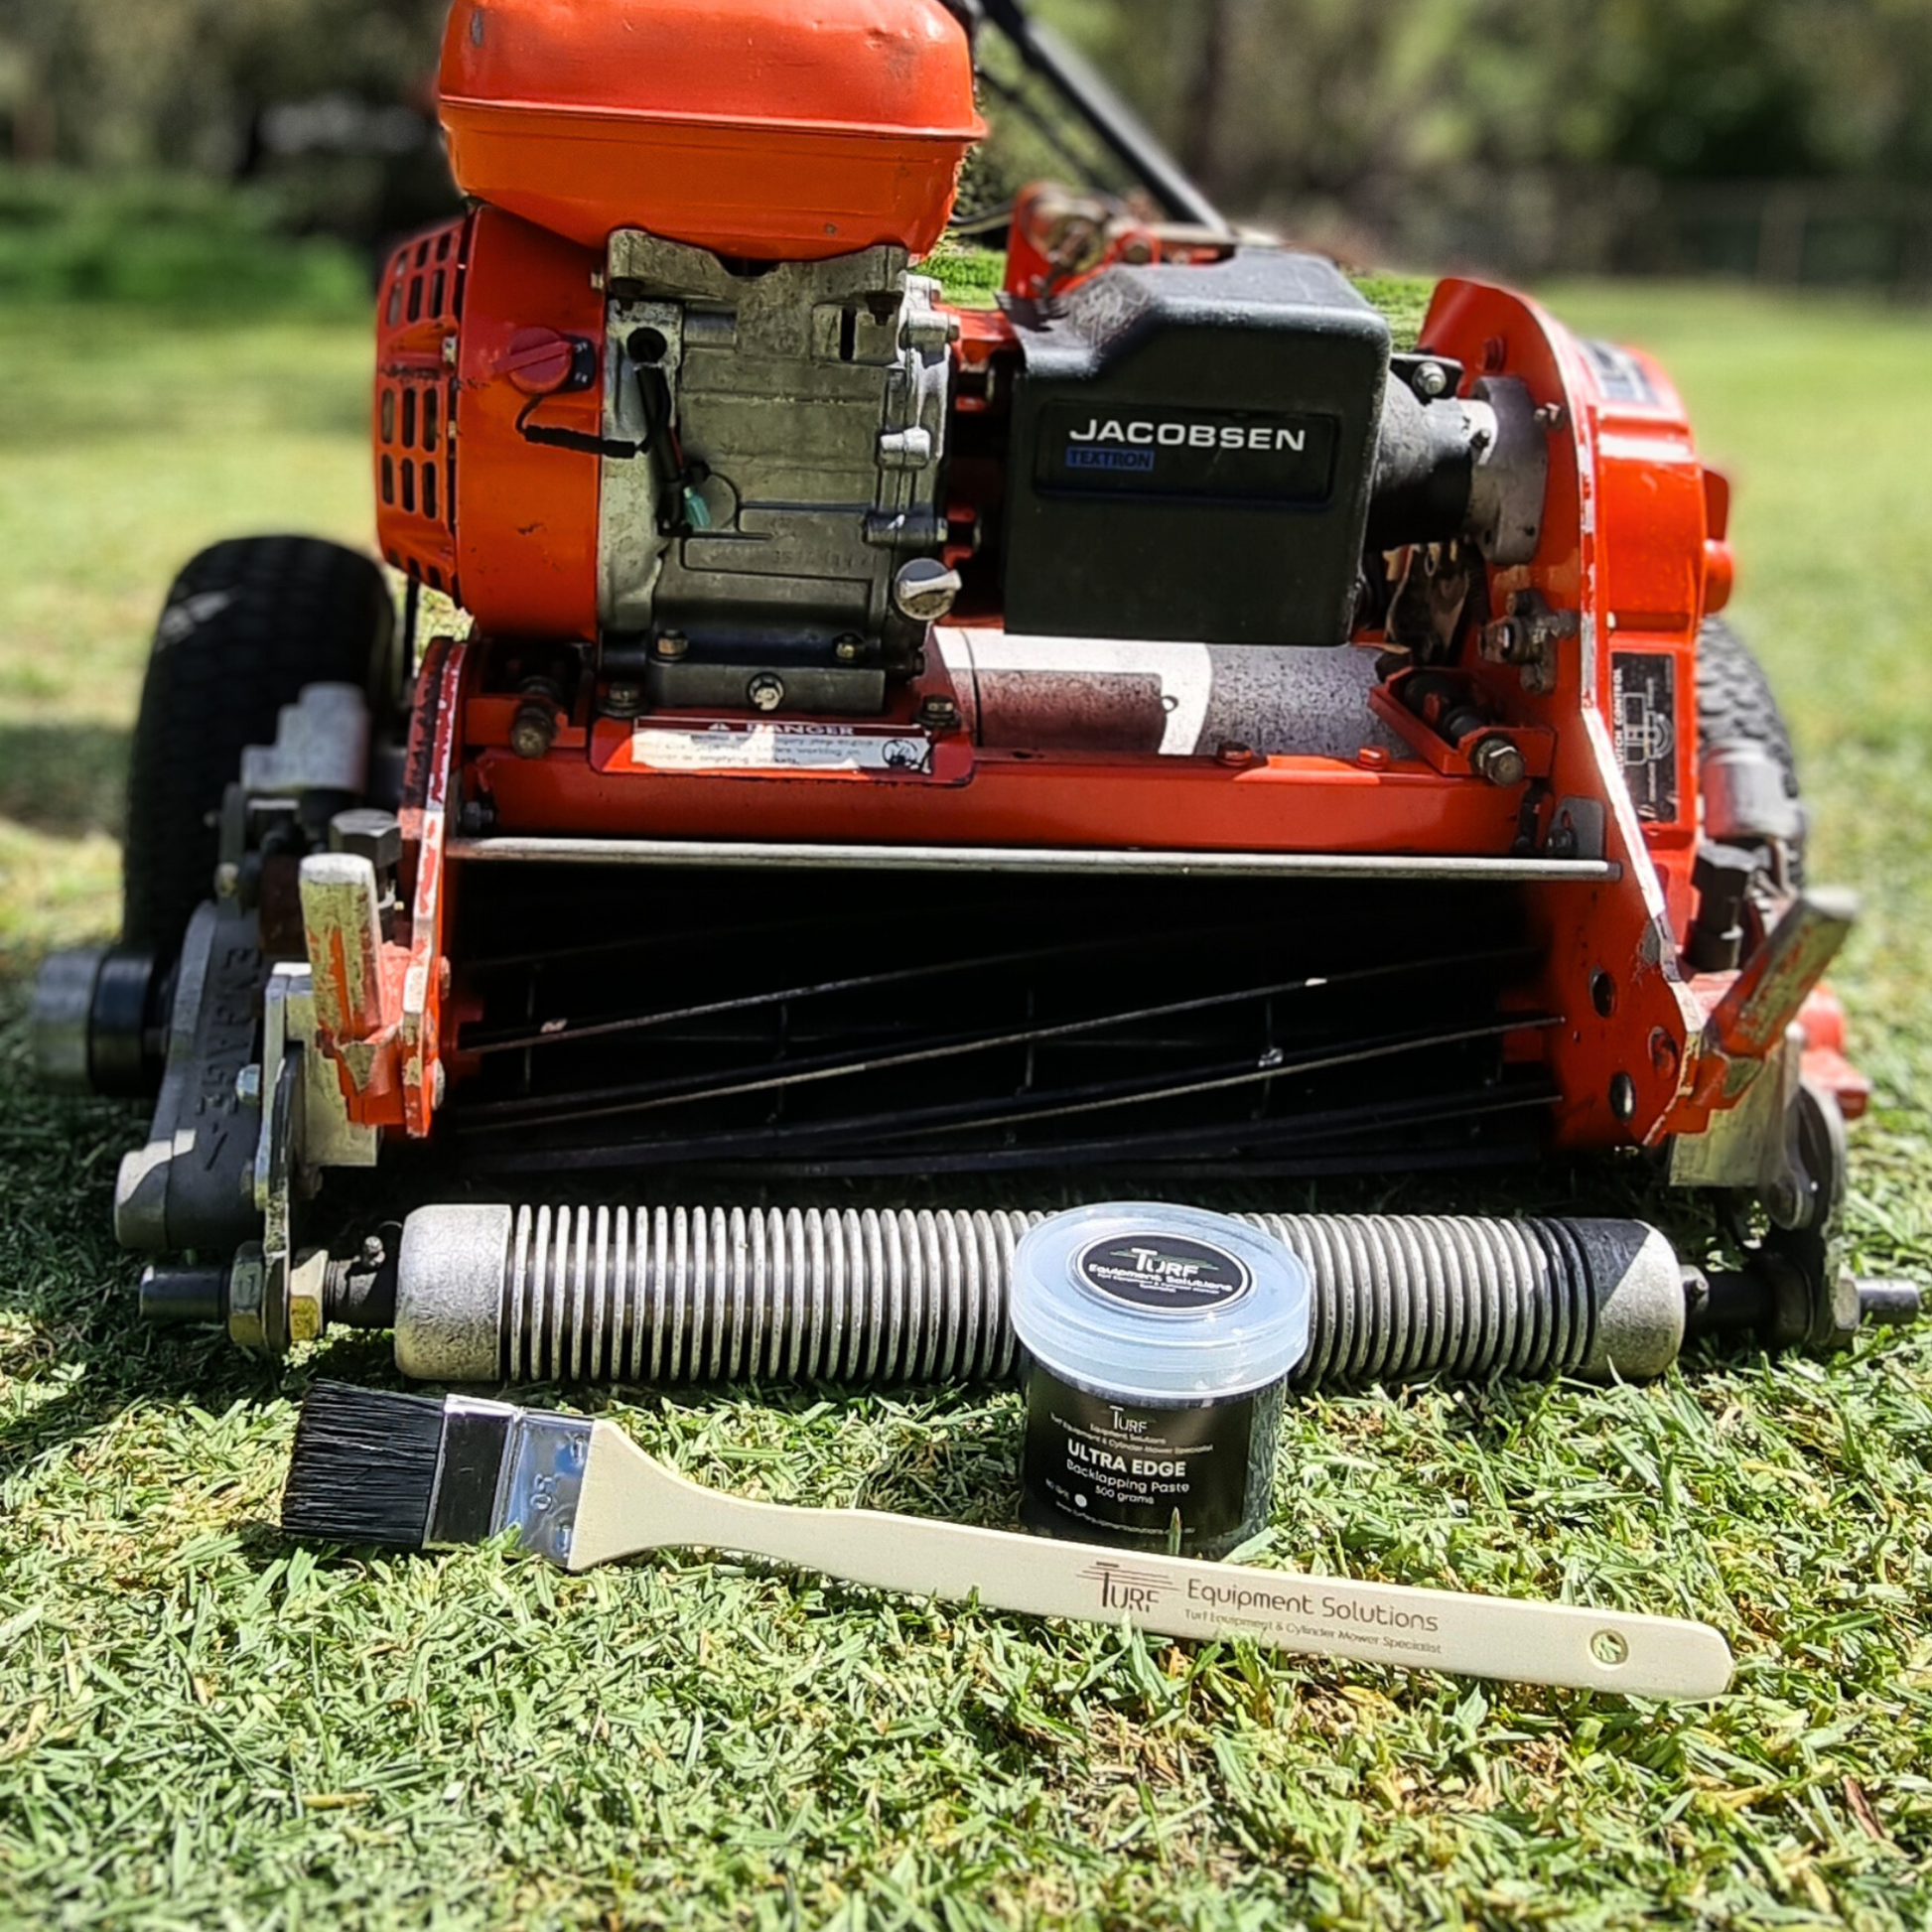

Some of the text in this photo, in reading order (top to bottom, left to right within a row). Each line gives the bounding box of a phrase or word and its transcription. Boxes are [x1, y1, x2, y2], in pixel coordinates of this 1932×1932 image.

[1069, 419, 1305, 451] JACOBSEN
[1068, 450, 1152, 469] TEXTRON
[1613, 668, 1623, 726] CONTROL
[747, 723, 854, 735] DANGER
[1088, 1263, 1163, 1283] Equipment
[1166, 1276, 1233, 1292] Solutions
[1131, 1247, 1199, 1278] TURF
[1109, 1405, 1149, 1434] TURF
[1067, 1438, 1186, 1477] ULTRA EDGE
[1066, 1458, 1148, 1494] Backlapping
[1152, 1481, 1190, 1493] Paste
[1095, 1485, 1155, 1505] 500 grams
[1096, 1562, 1160, 1613] TURF
[1187, 1579, 1439, 1632] Equipment Solutions
[1184, 1608, 1208, 1621] Turf
[1286, 1622, 1334, 1638] Cylinder
[1337, 1629, 1380, 1646] Mower
[1383, 1636, 1443, 1654] Specialist
